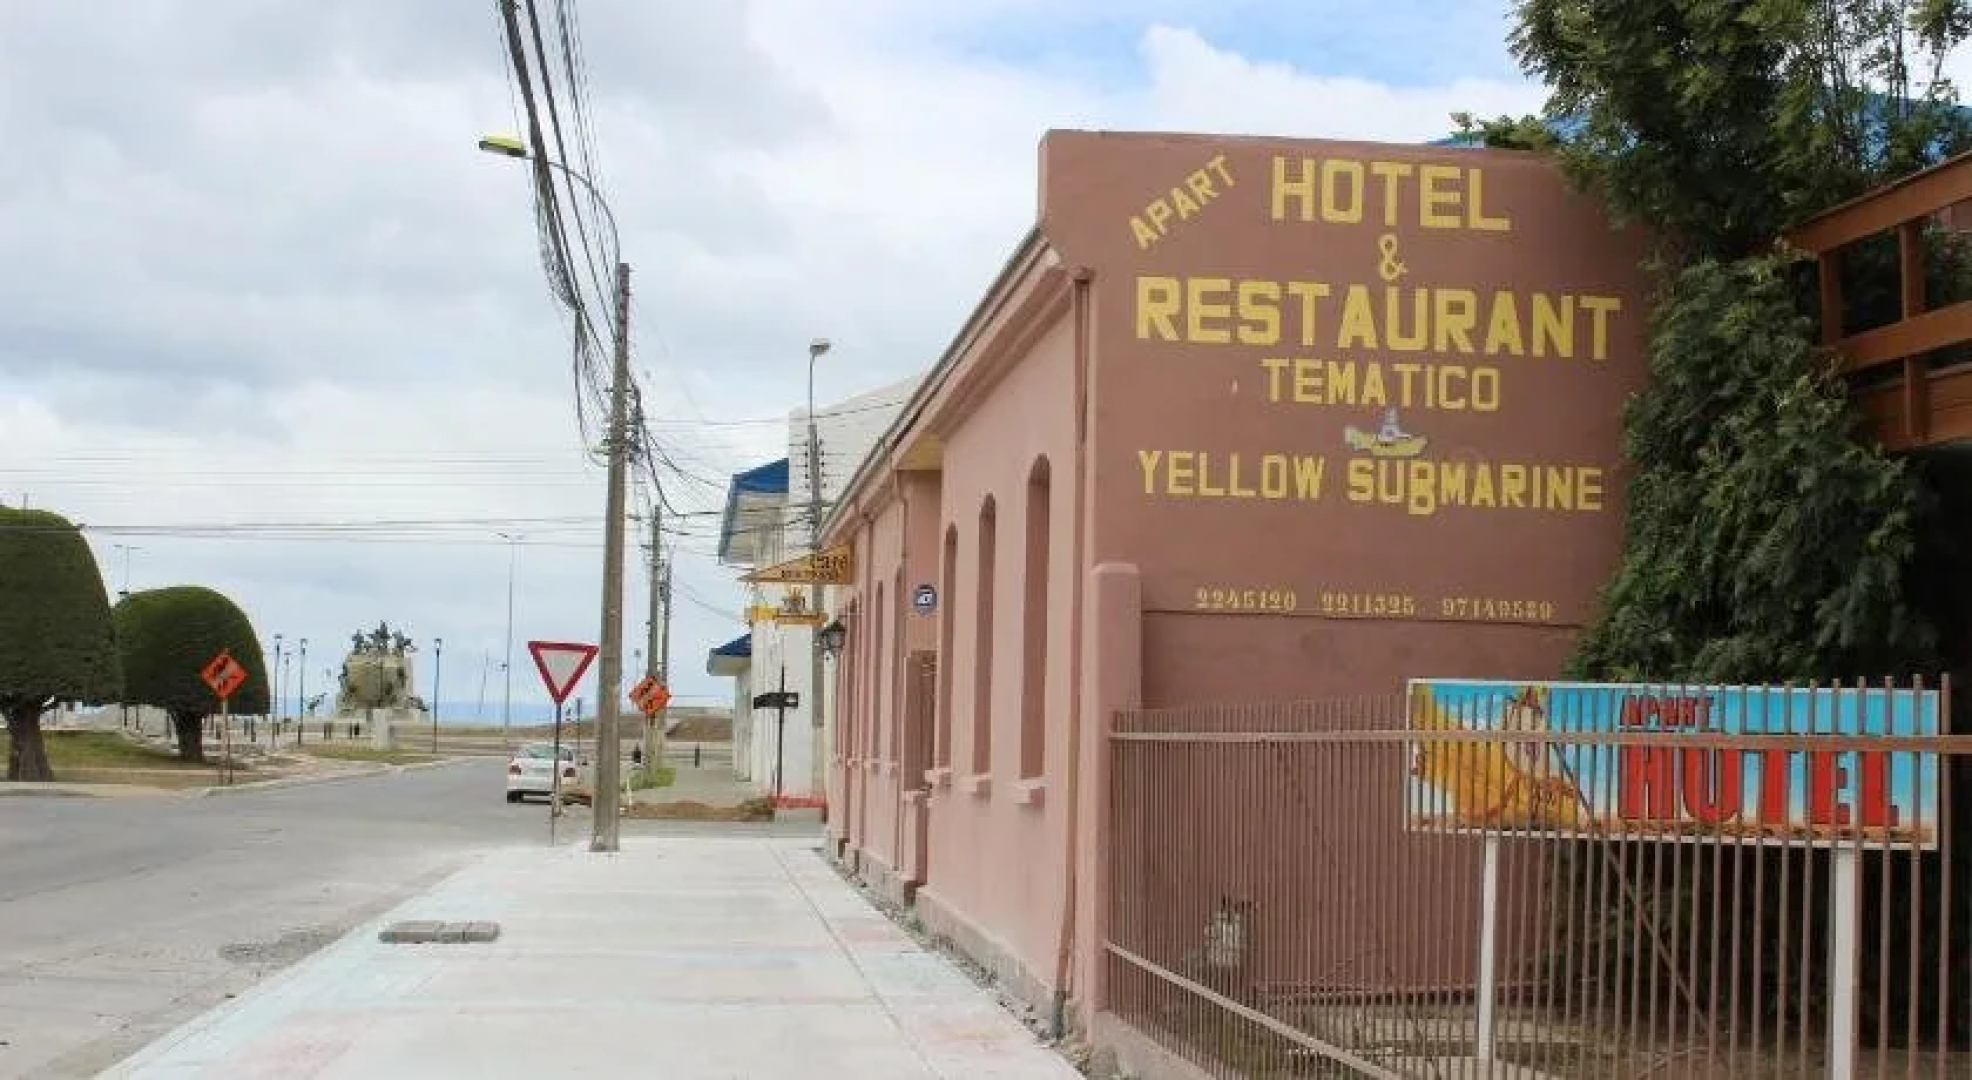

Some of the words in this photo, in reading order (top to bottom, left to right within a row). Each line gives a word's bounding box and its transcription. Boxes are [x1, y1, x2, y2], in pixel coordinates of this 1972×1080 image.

[1128, 154, 1236, 250] APART
[1270, 155, 1512, 232] HOTEL
[1377, 233, 1409, 281] &
[1135, 276, 1621, 360] RESTAURANT
[1261, 357, 1500, 412] TEMATICO
[1137, 449, 1325, 501] YELLOW
[1347, 458, 1603, 516] SUBMARINE
[1617, 731, 1900, 827] HOTEL
